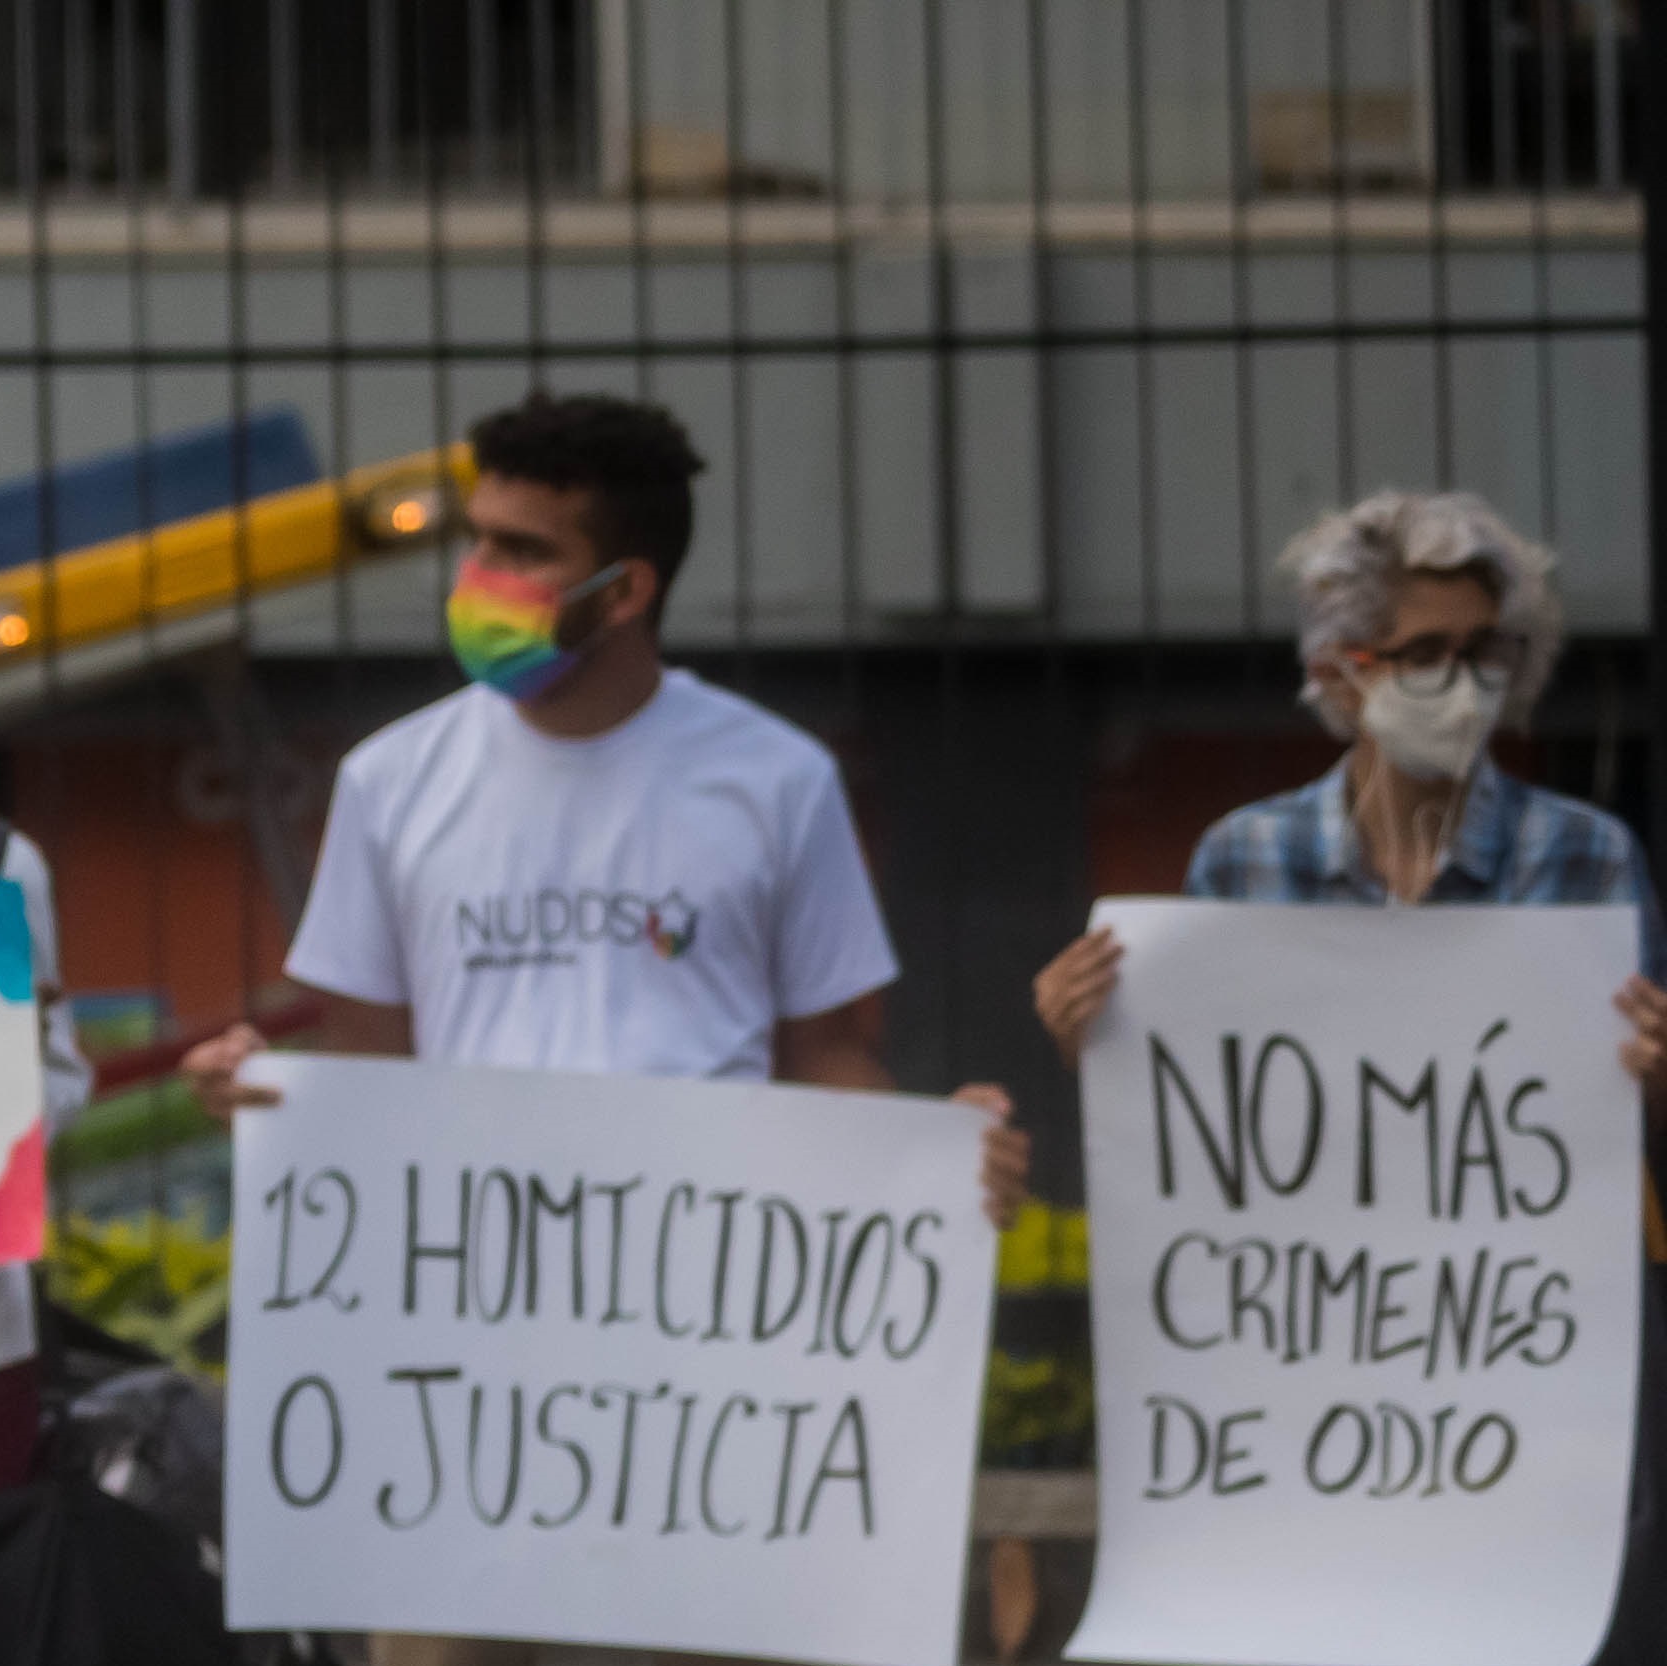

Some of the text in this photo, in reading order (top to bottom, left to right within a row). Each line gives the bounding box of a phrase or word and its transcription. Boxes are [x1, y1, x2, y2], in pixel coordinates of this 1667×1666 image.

[1150, 1020, 1570, 1220] NO MÁS
[263, 1165, 942, 1359] 12 HOMICIDIOS
[1153, 1236, 1576, 1378] CRIMENES
[271, 1367, 873, 1540] O JUSTICIA
[1146, 1397, 1517, 1499] DE ODIO
